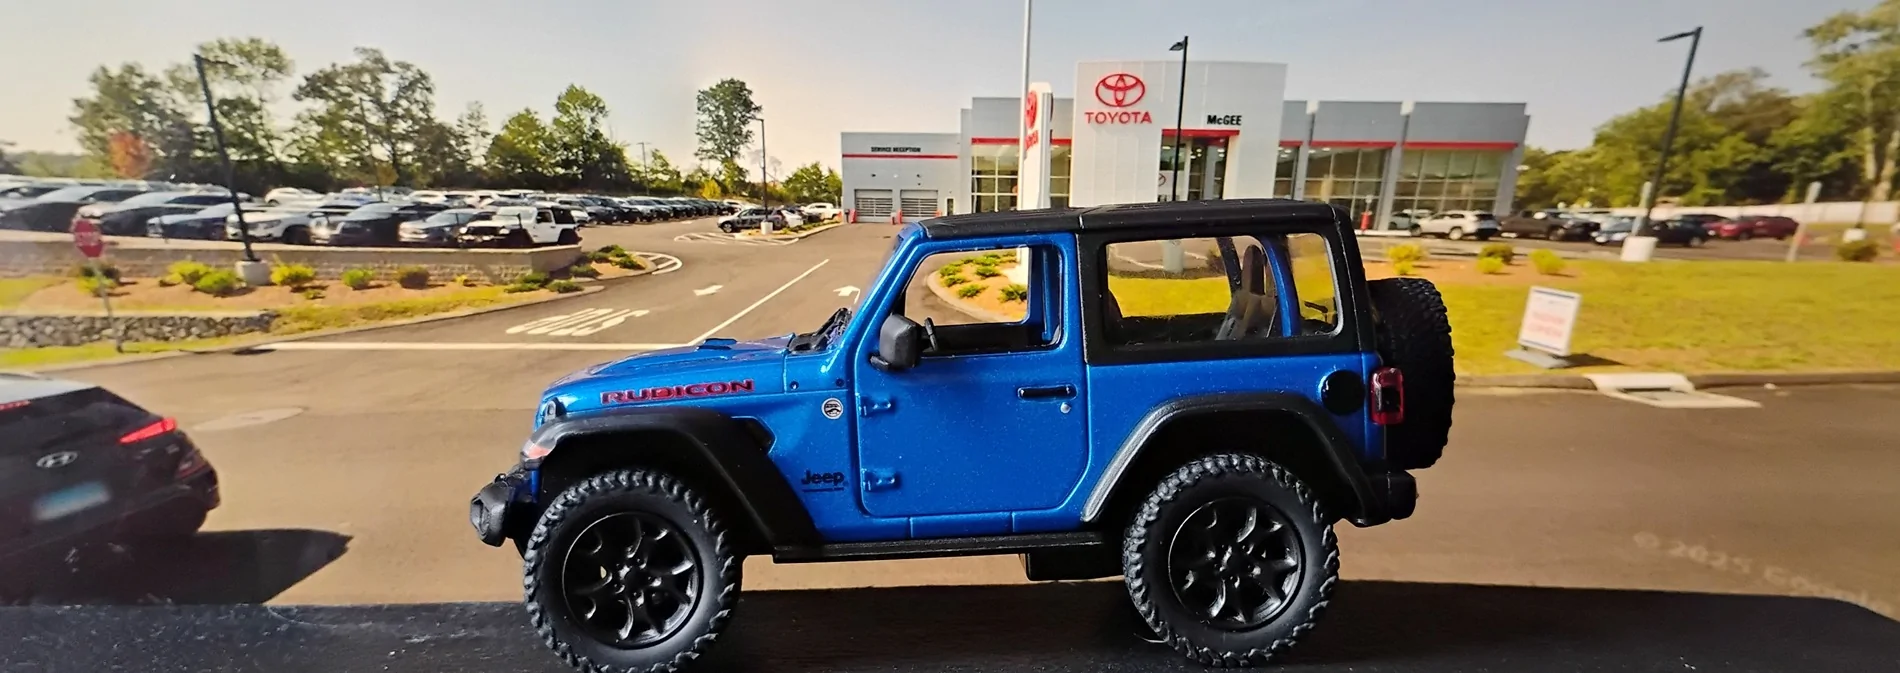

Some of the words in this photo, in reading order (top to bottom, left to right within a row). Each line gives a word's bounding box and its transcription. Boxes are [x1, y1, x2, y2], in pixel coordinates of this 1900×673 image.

[1085, 112, 1153, 124] TOYOTA
[1206, 114, 1242, 126] McGEE
[600, 379, 755, 404] RUBICON
[801, 469, 845, 486] Jeep
